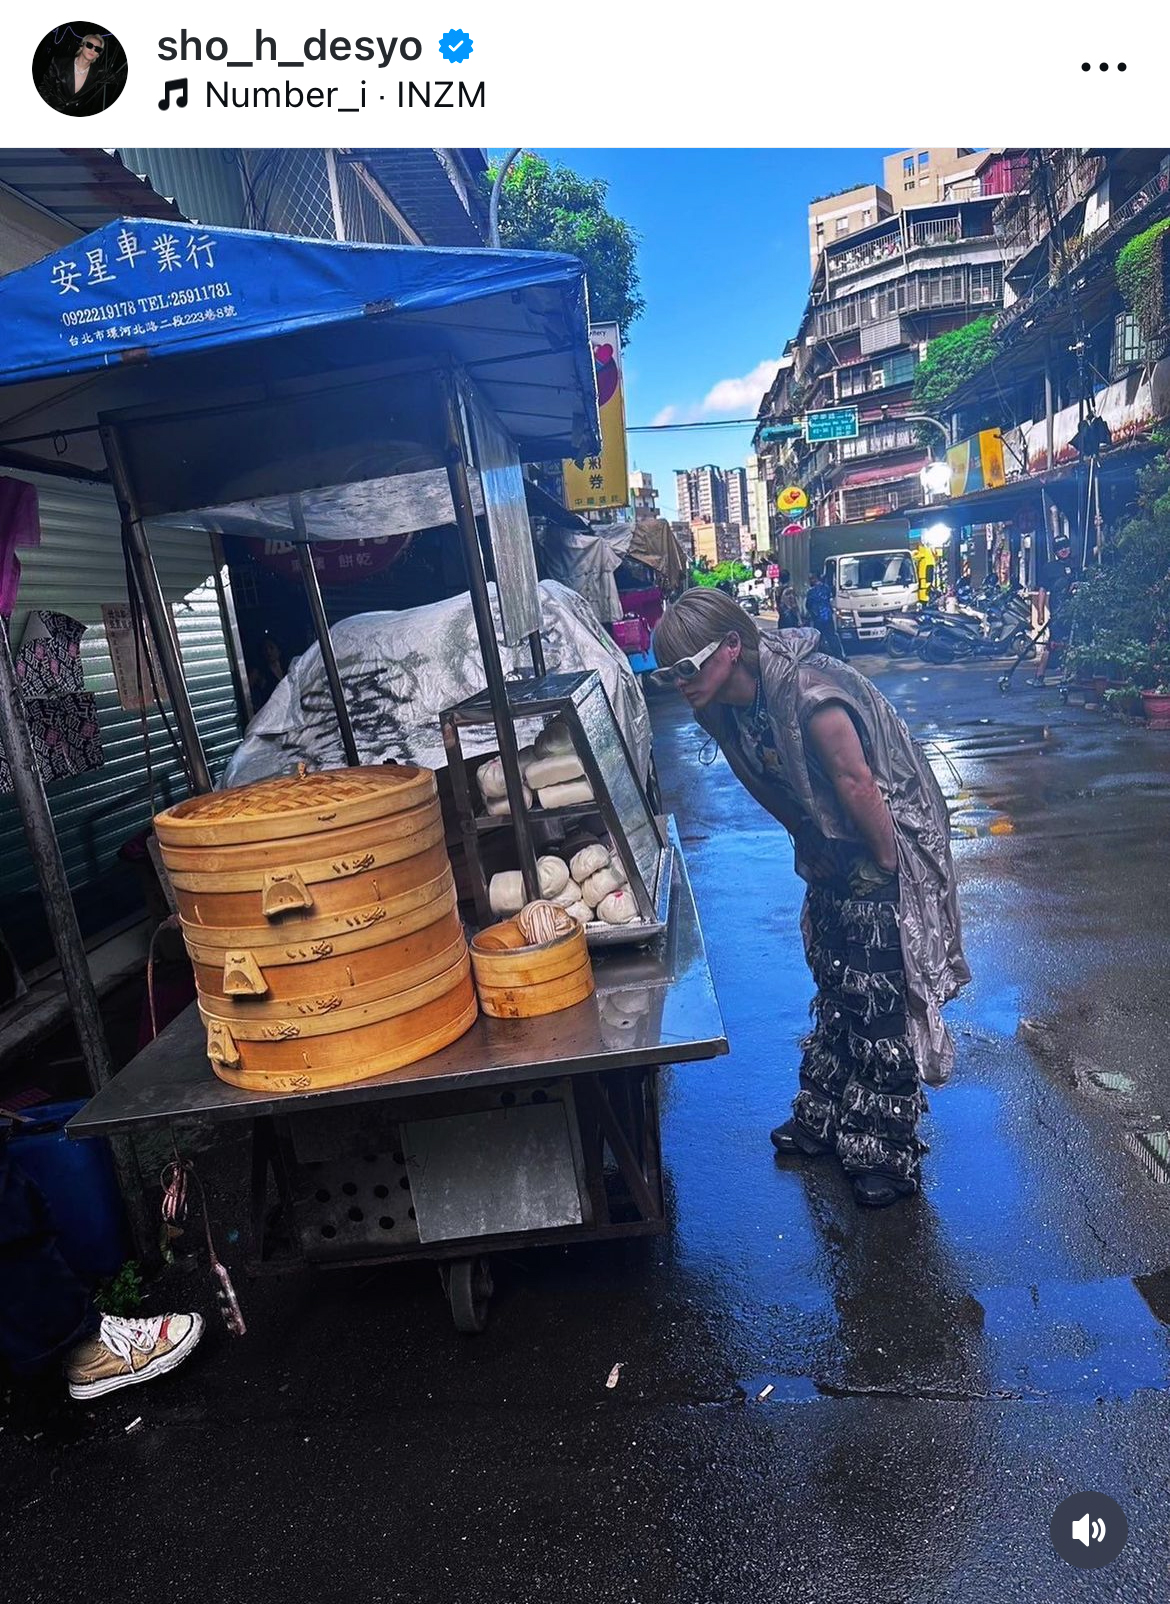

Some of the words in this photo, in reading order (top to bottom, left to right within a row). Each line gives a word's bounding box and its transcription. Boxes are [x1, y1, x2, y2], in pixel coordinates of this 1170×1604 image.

[50, 228, 218, 296] 安星車業行
[61, 300, 137, 327] 0922219178
[137, 282, 233, 313] TEL:25911781
